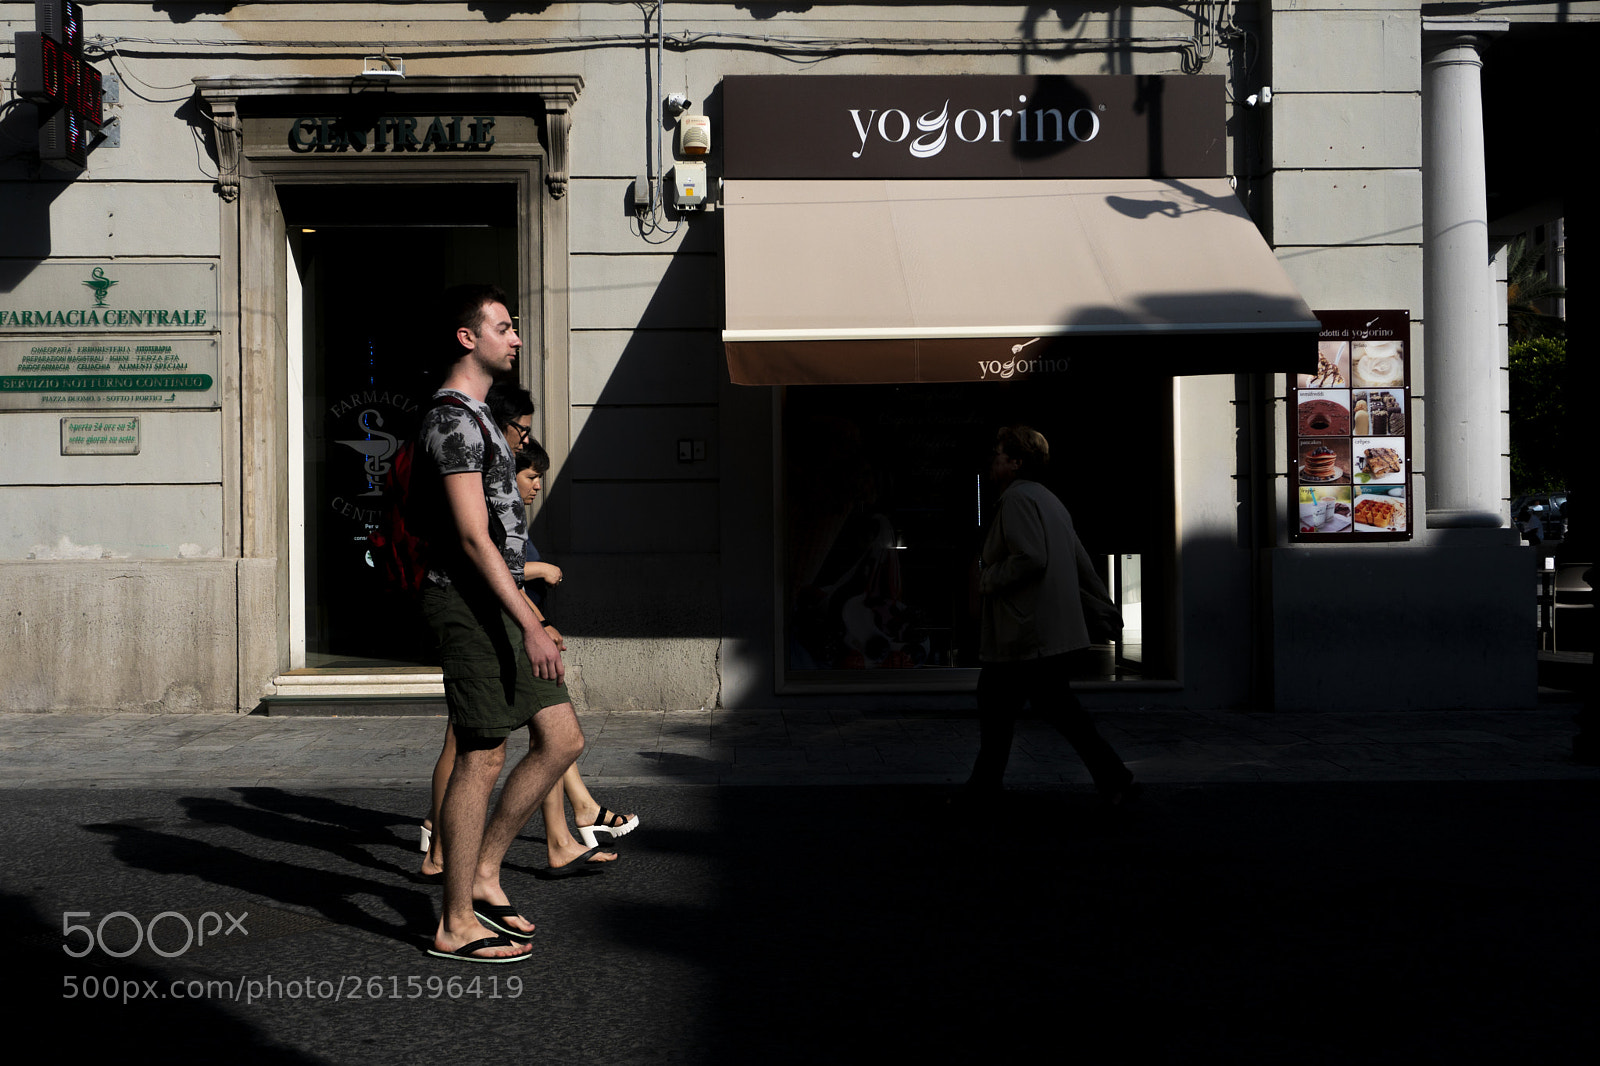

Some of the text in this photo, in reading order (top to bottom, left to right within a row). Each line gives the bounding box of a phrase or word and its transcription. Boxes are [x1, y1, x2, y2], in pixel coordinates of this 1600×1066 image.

[848, 98, 1100, 158] yogorino
[0, 309, 207, 327] FARMACIA CENTRALE
[1319, 327, 1394, 340] odotti di yogorino
[22, 355, 67, 363] PREPARAZIONI
[136, 355, 163, 363] TERZA
[118, 363, 153, 371] ALIMENTI
[153, 362, 188, 371] SPECIALI
[978, 354, 1068, 380] yogorino
[3, 376, 203, 389] SERVIZIO NOTTURNO CONTINUO
[93, 422, 103, 431] 24
